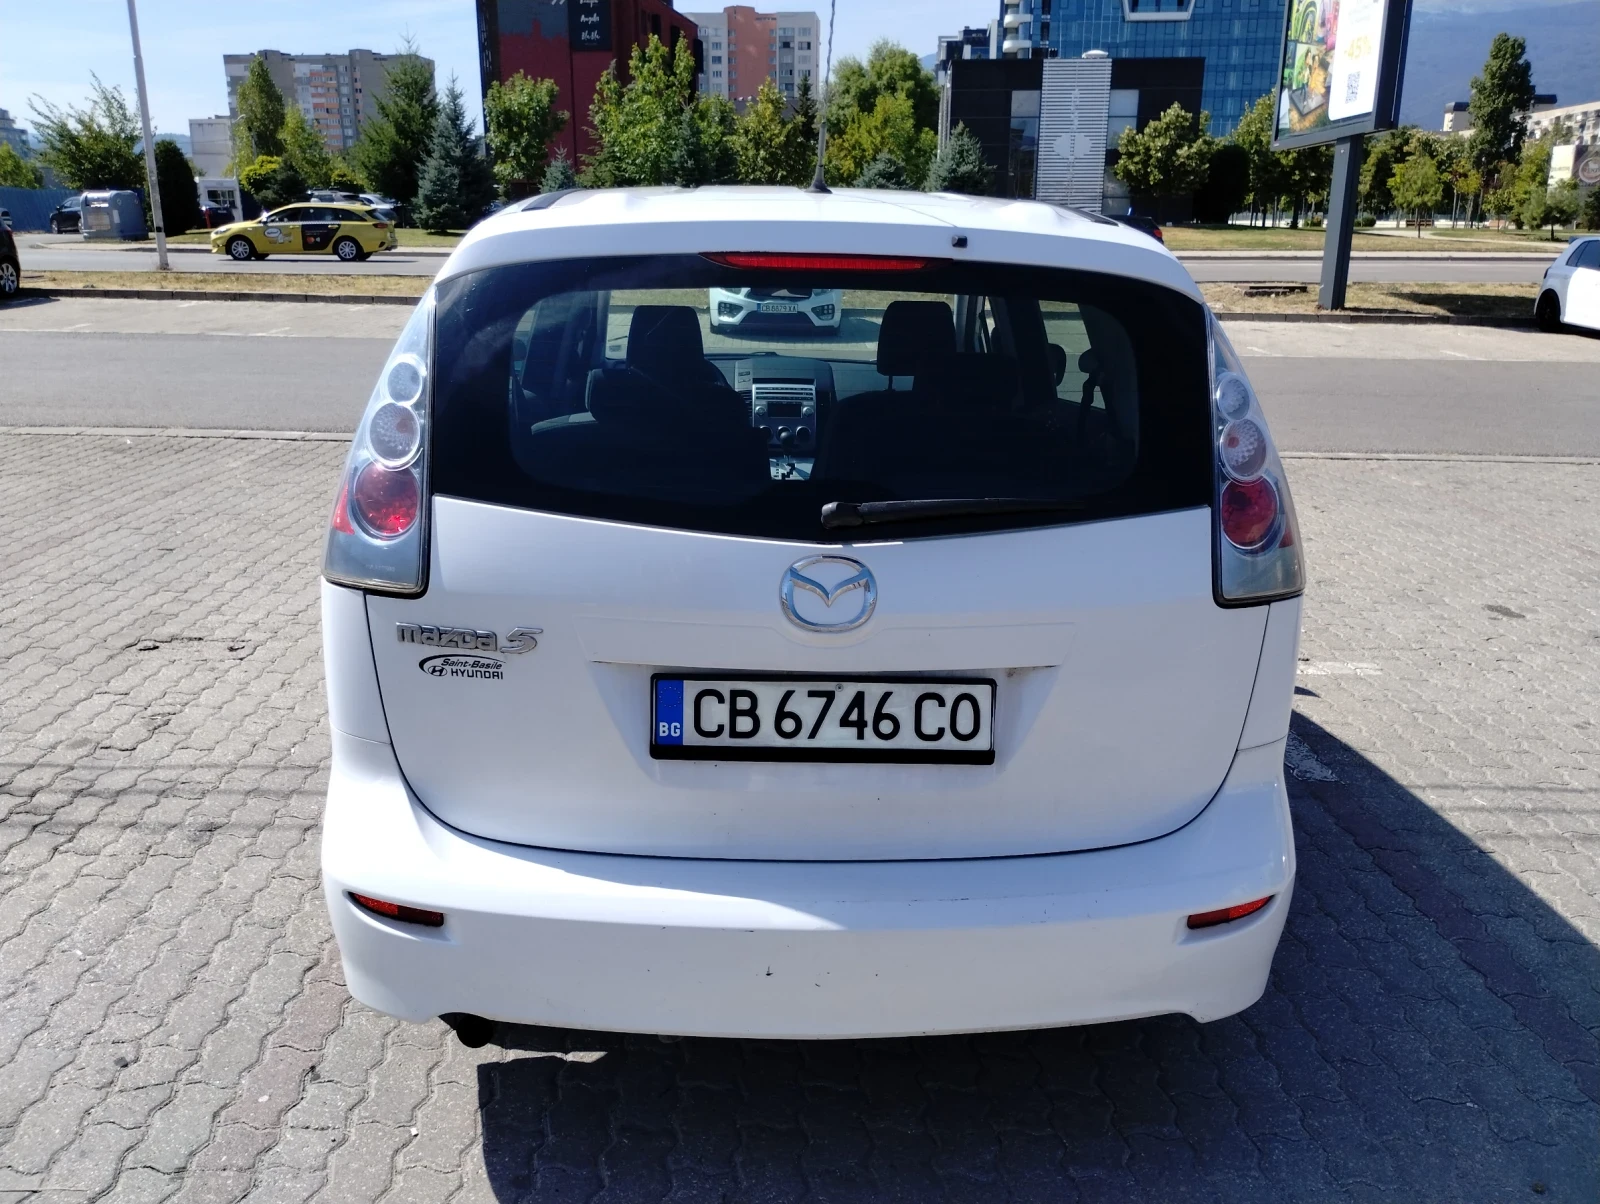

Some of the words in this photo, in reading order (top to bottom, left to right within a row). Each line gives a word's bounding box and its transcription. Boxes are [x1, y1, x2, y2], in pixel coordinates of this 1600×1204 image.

[500, 626, 543, 654] 5
[441, 658, 502, 670] Saint-Basile
[450, 668, 503, 680] HYUNDAI
[693, 688, 761, 739] CB
[774, 689, 901, 741] 6746
[659, 721, 681, 736] BG
